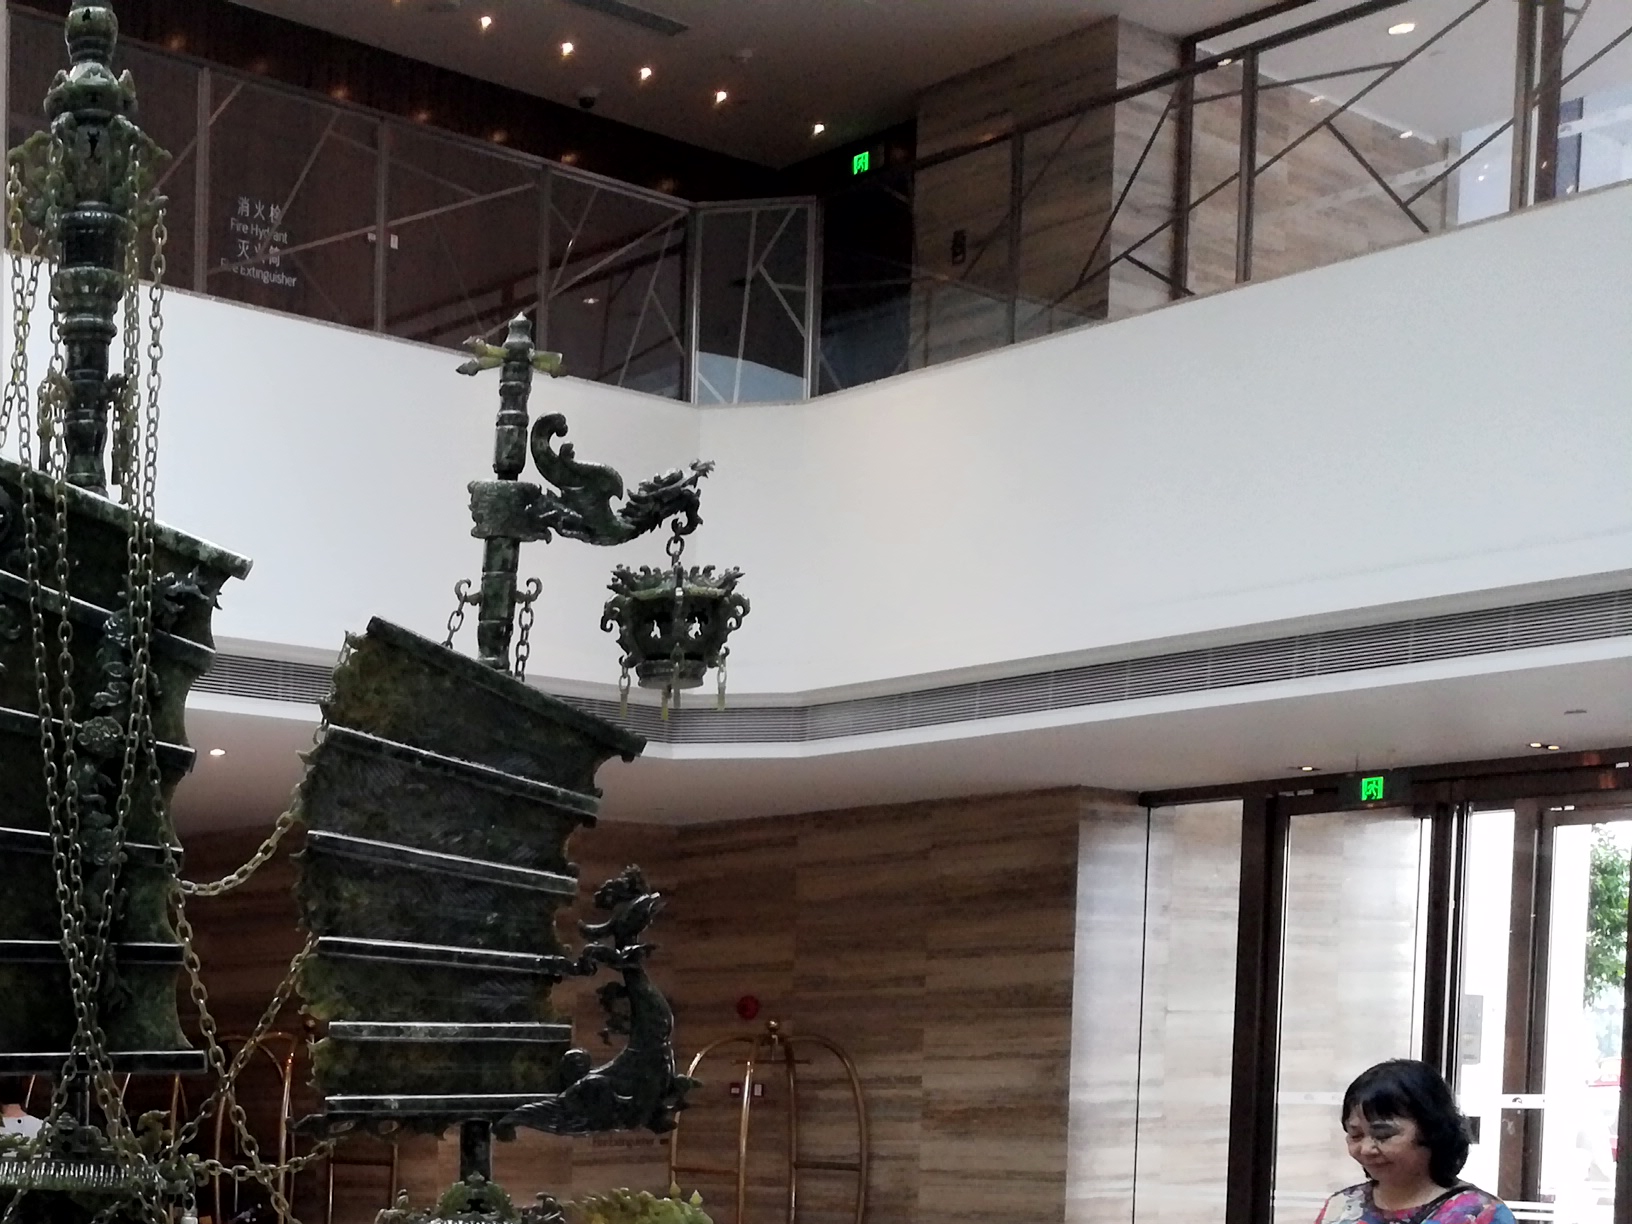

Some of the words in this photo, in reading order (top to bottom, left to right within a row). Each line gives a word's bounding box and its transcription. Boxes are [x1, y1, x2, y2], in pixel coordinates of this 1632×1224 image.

[237, 195, 281, 223] 消火栓
[230, 217, 248, 233] Fire
[250, 223, 288, 245] Hydant
[220, 257, 239, 273] Fe
